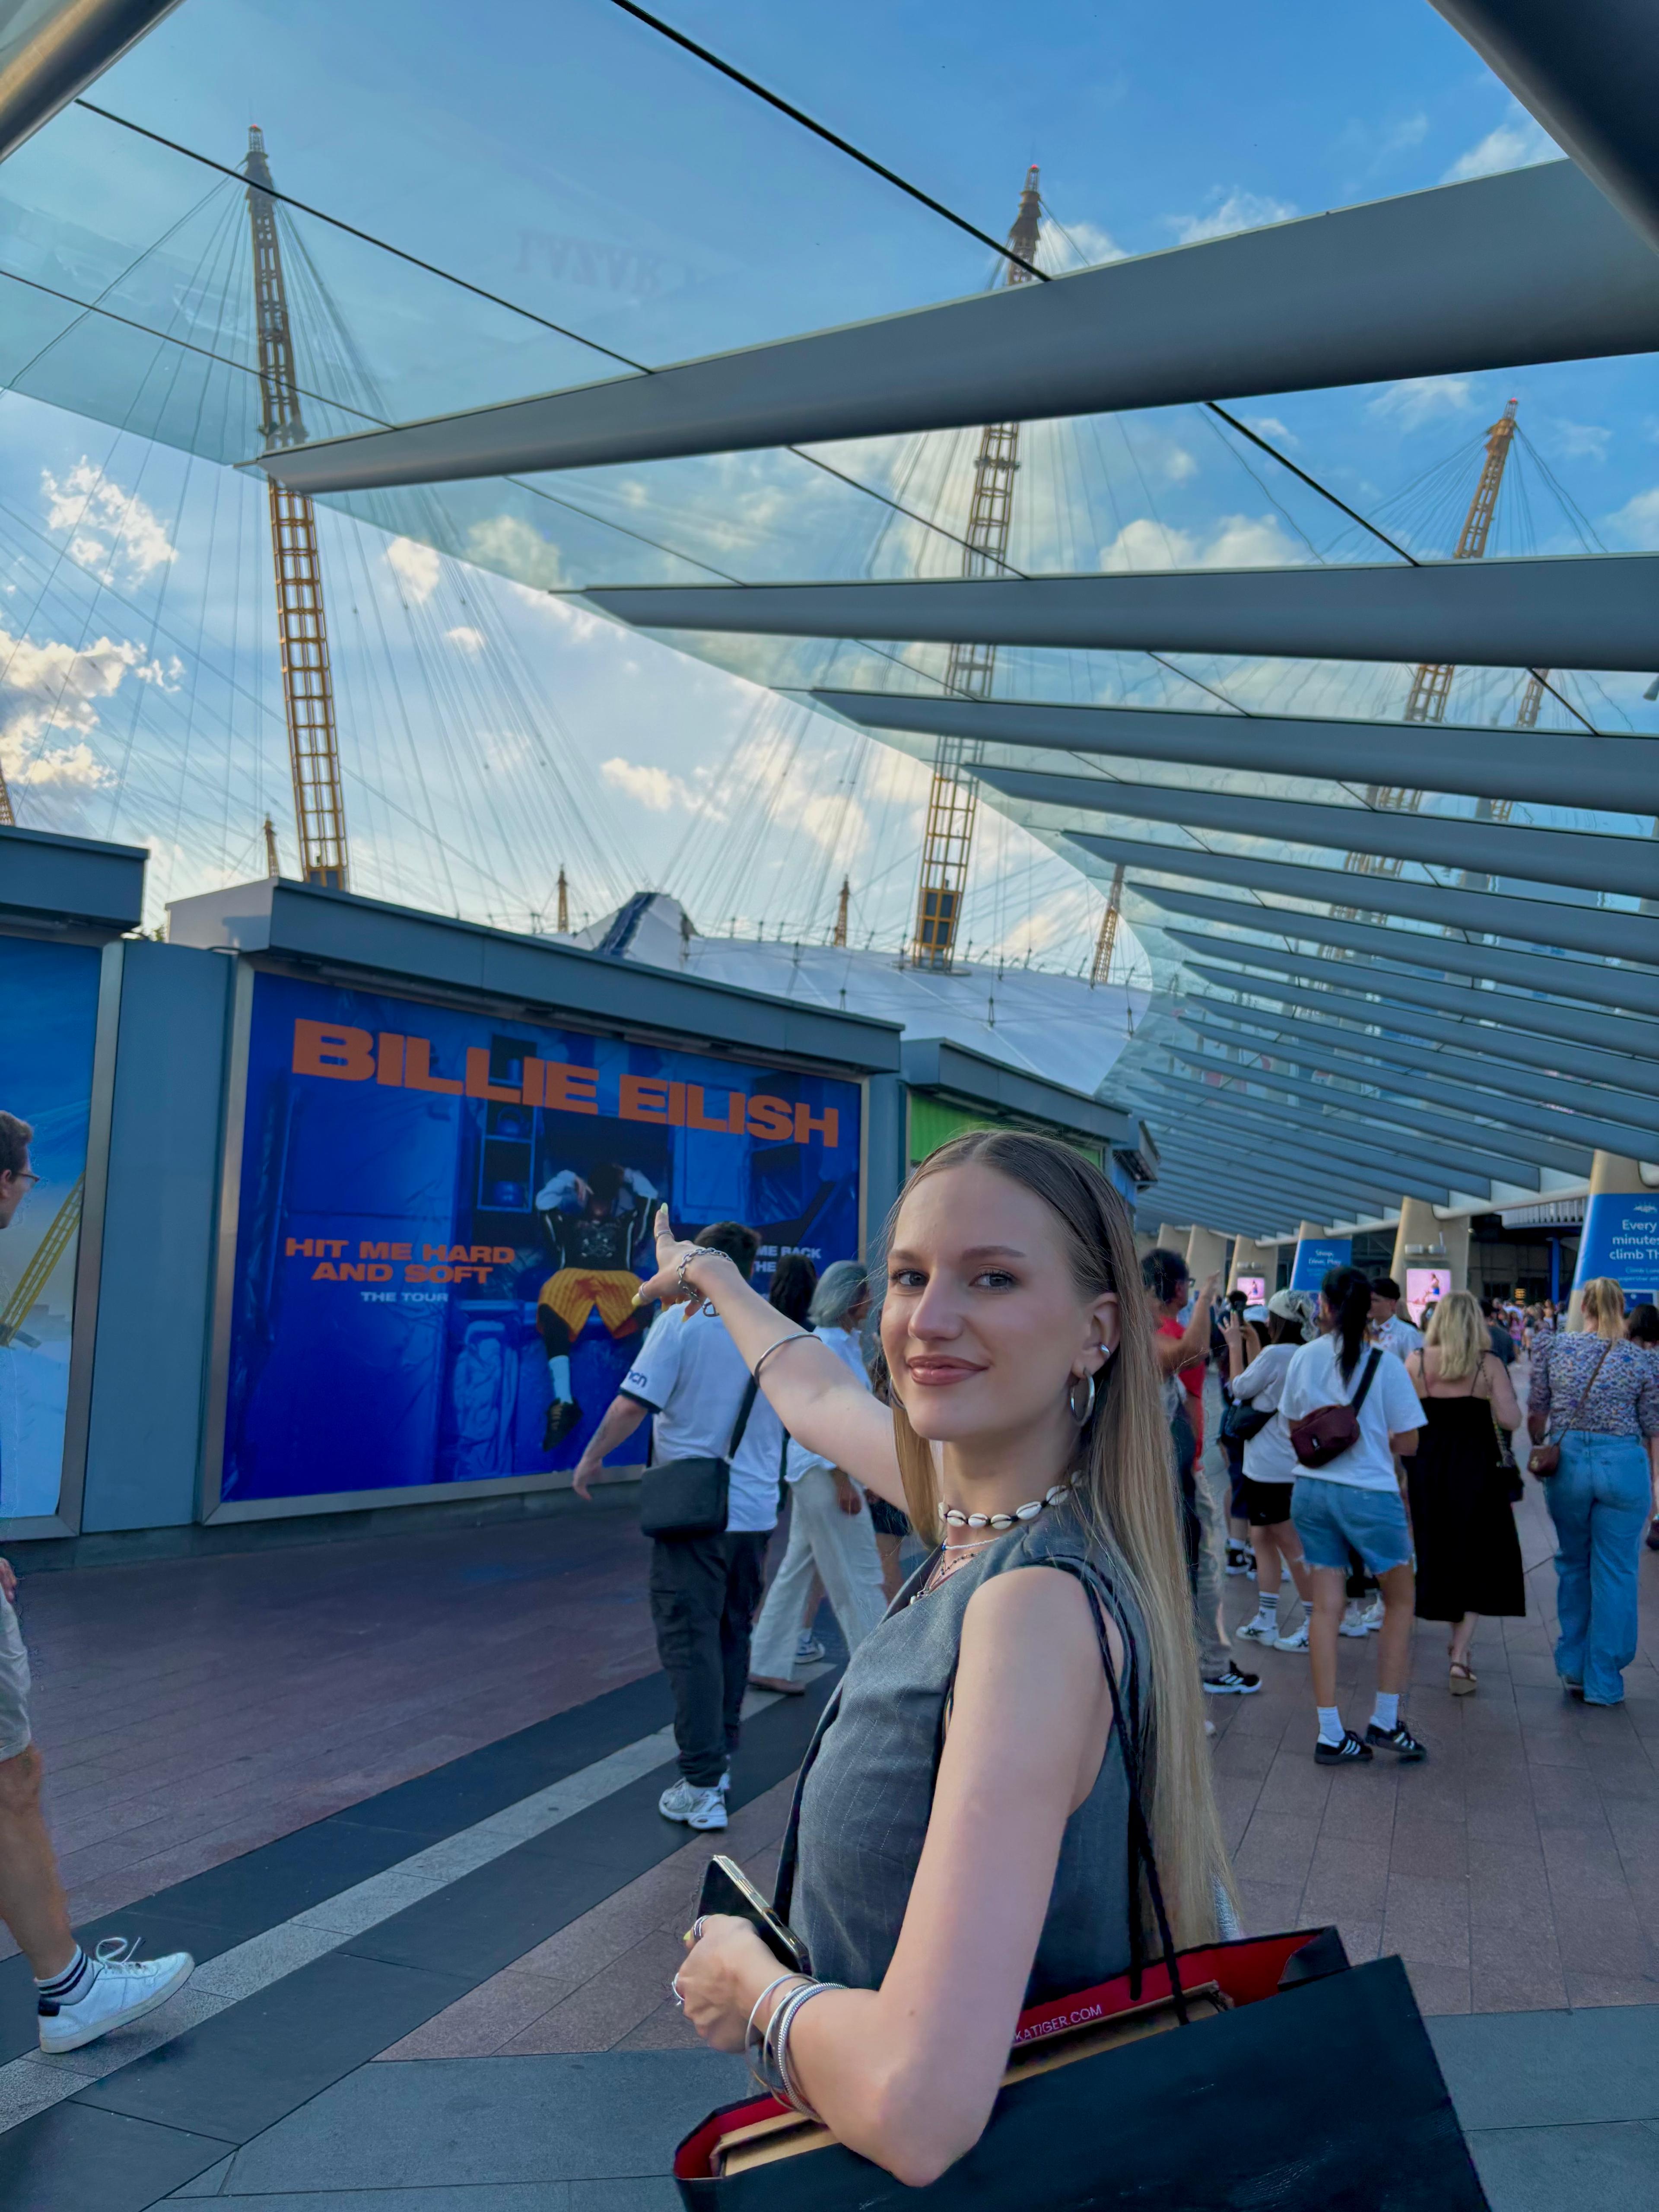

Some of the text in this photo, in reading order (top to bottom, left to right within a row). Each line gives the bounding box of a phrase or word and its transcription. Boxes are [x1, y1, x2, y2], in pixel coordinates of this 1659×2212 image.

[292, 1018, 839, 1147] BILLIE EILISH
[1622, 1219, 1657, 1233] Every
[285, 1238, 515, 1264] HIT ME HARD
[756, 1245, 778, 1256] ME
[1609, 1248, 1644, 1260] climb
[311, 1262, 493, 1284] AND SOFT
[361, 1292, 448, 1303] THE TOUR
[1015, 2004, 1102, 2041] KATIGER.COM
